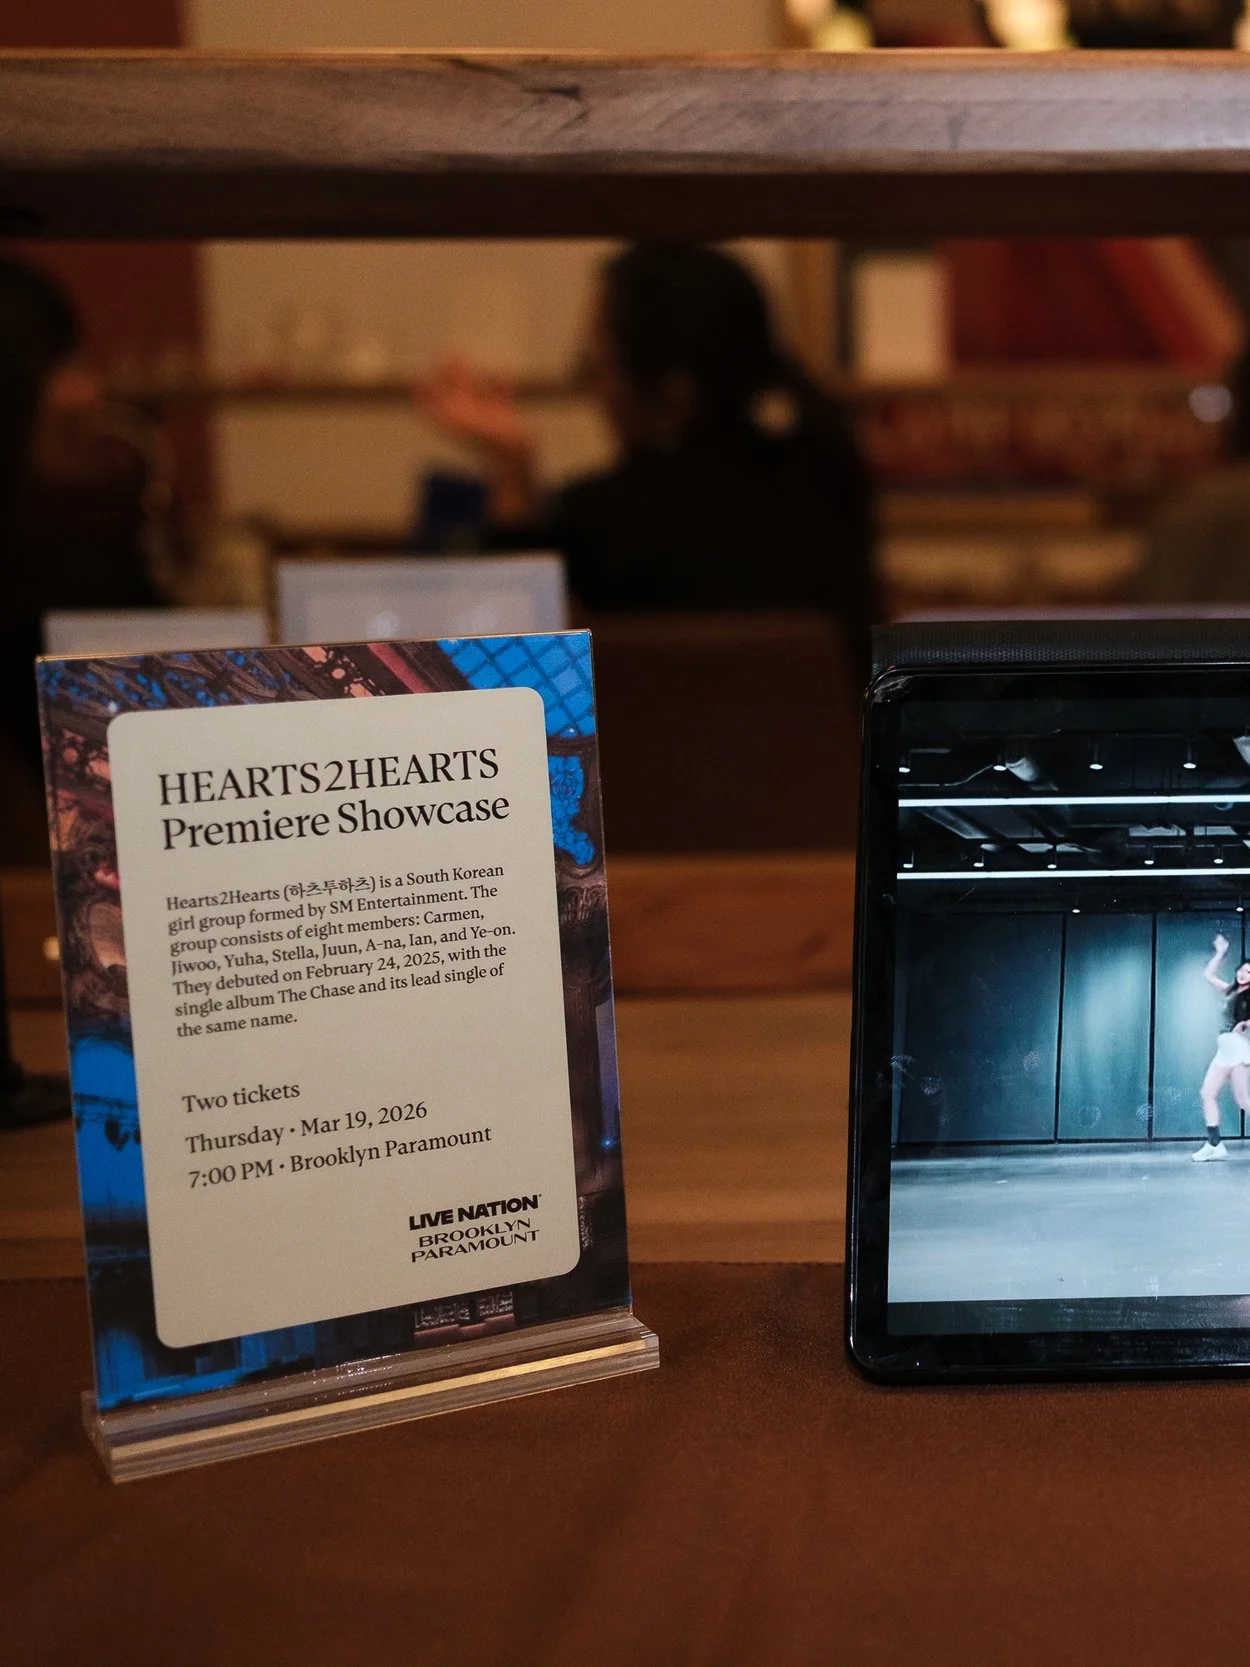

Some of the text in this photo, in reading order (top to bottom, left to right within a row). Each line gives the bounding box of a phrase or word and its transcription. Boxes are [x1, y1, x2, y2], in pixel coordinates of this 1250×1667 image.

[158, 748, 499, 806] HEARTS2HEARTS
[161, 797, 510, 851] Premiere Showcase
[166, 866, 505, 911] Hearts2Hearts (하츠투하츠) is a South Korean
[168, 884, 498, 936] girl group formed by SM Entertainment. The
[170, 909, 485, 958] group consists of eight members: Carmen,
[171, 925, 516, 976] Jiwoo, Yuha, Stella, Juun, A-na, Ian, and Ye-on.
[172, 943, 507, 996] They debuted on February 24, 2025, with the
[175, 961, 505, 1018] single album The Chase and its lead single of
[176, 1013, 298, 1038] the same name.
[181, 1083, 301, 1113] Two tickets
[184, 1125, 284, 1154] Thursday
[300, 1117, 341, 1137] Mar
[344, 1110, 373, 1130] 19,
[377, 1101, 428, 1125] 2026
[188, 1164, 237, 1189] 7:00
[241, 1158, 274, 1181] PM
[289, 1144, 381, 1173] Brooklyn
[384, 1127, 492, 1158] Paramount
[408, 1208, 454, 1231] LIVE
[418, 1217, 531, 1249] BROOKLYN
[411, 1229, 540, 1264] PARAMOUNT
